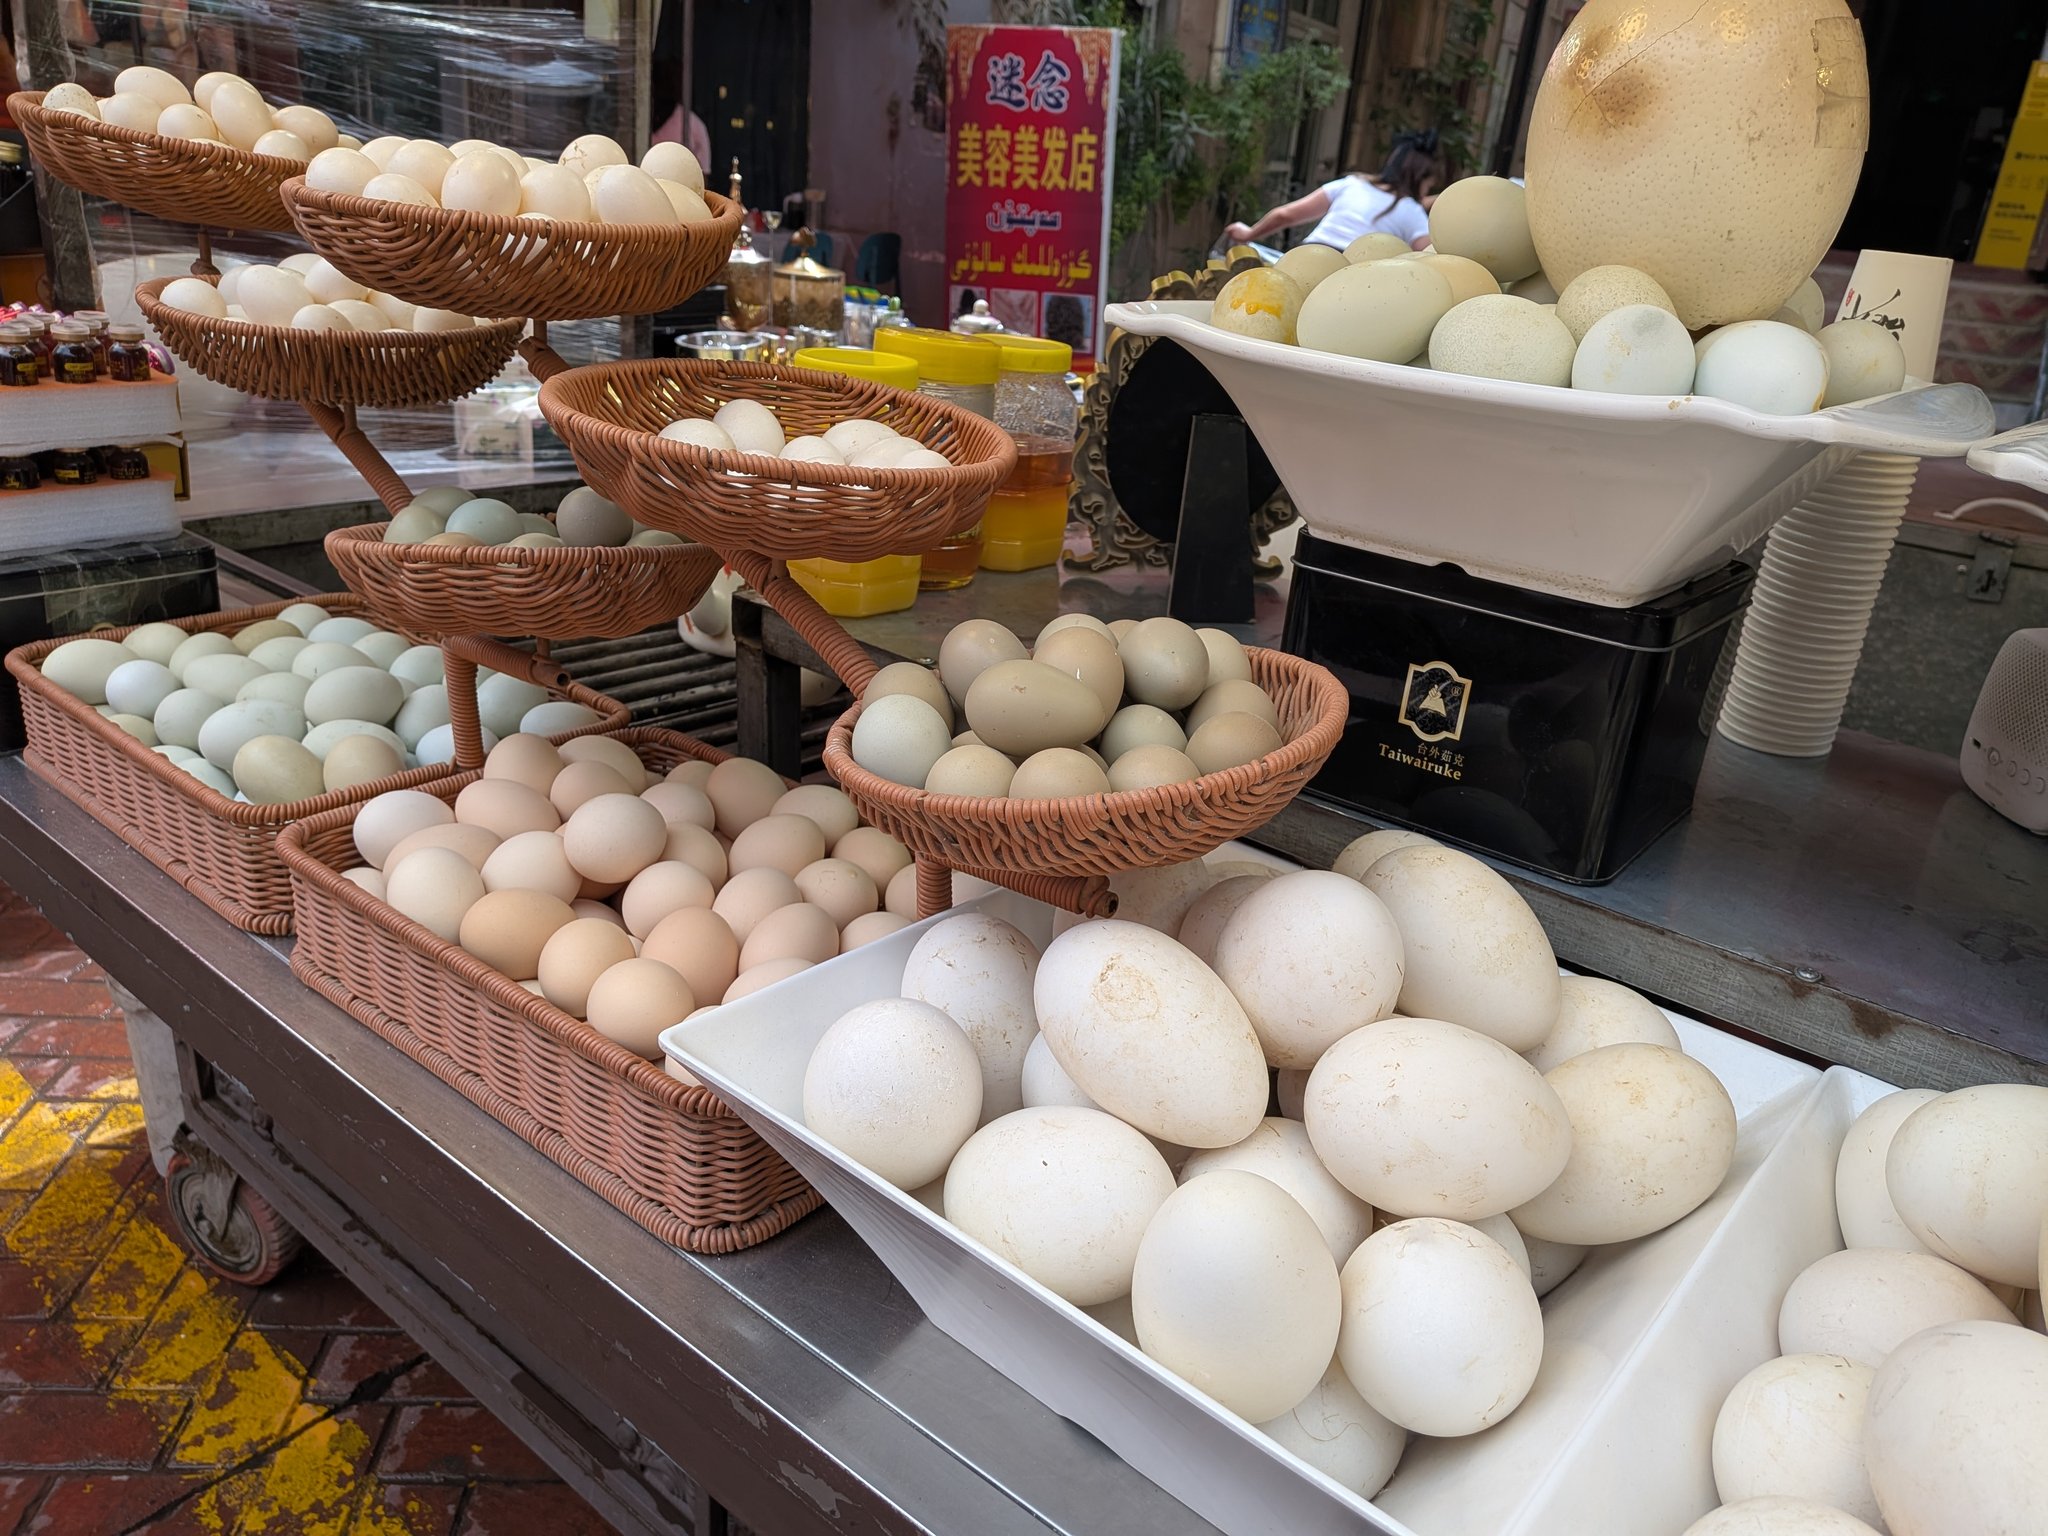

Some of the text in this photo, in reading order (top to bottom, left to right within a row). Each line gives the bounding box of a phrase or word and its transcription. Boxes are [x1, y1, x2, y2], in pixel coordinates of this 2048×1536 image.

[956, 122, 1098, 192] 美容美发店
[1379, 743, 1462, 780] Taiwairuke
